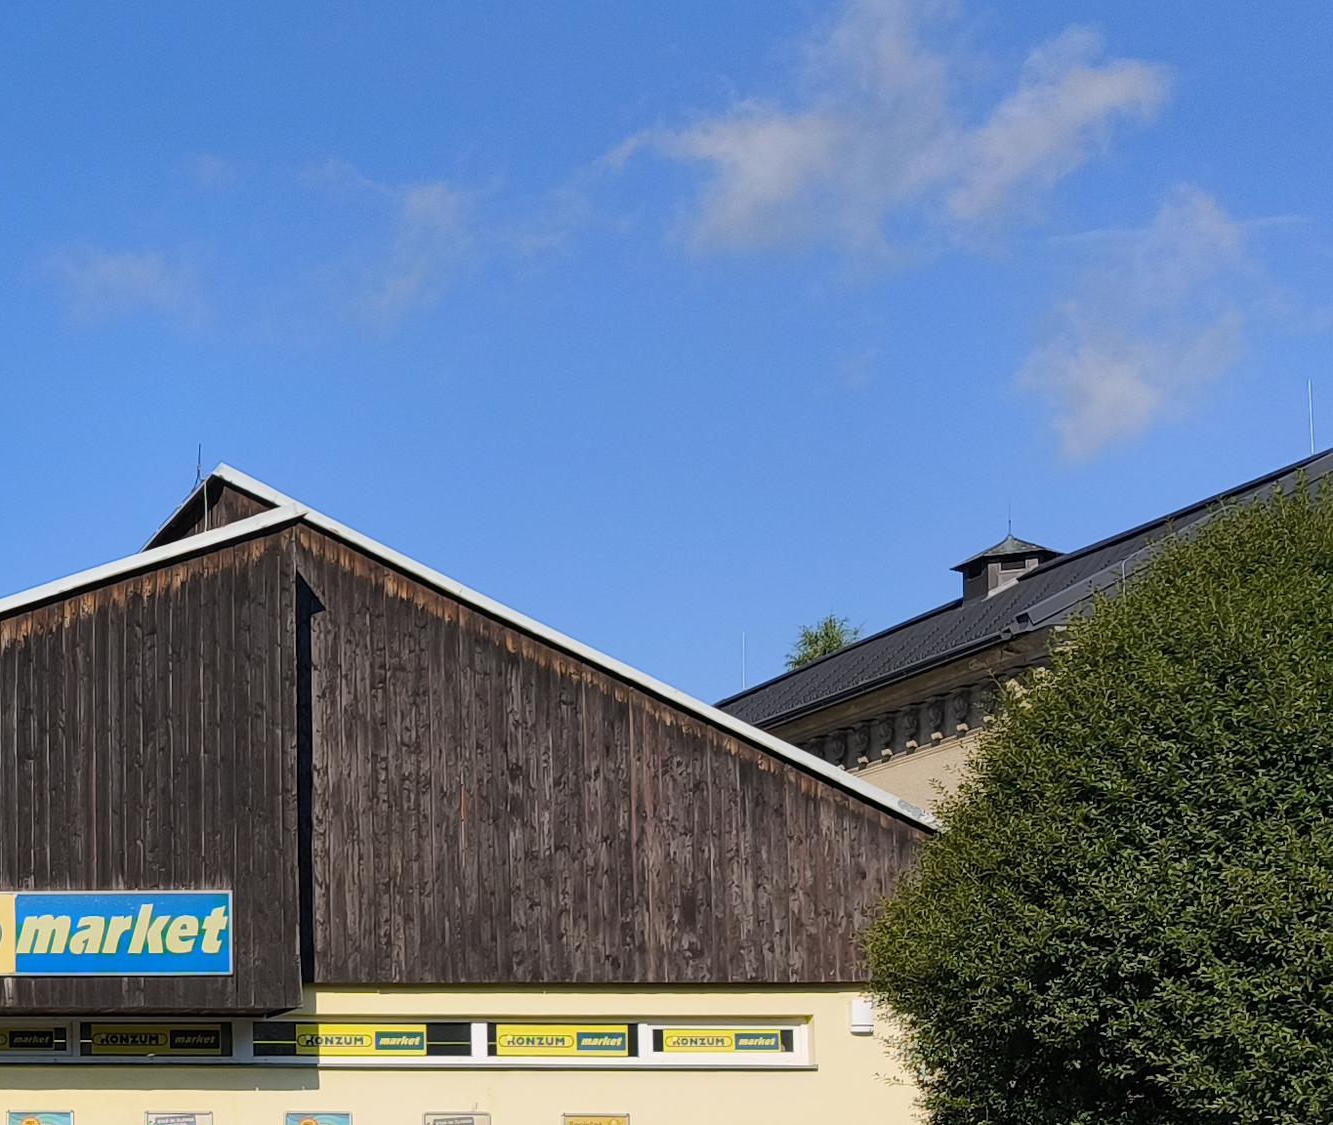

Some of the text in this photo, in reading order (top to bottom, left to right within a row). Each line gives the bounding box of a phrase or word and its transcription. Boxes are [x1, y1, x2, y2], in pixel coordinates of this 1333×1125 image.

[15, 904, 228, 954] market
[12, 1034, 51, 1044] market
[100, 1033, 217, 1045] KONZUM market
[304, 1035, 421, 1046] KONZUM market
[506, 1036, 623, 1046] KONZUM market
[671, 1036, 776, 1046] KONZUM market
